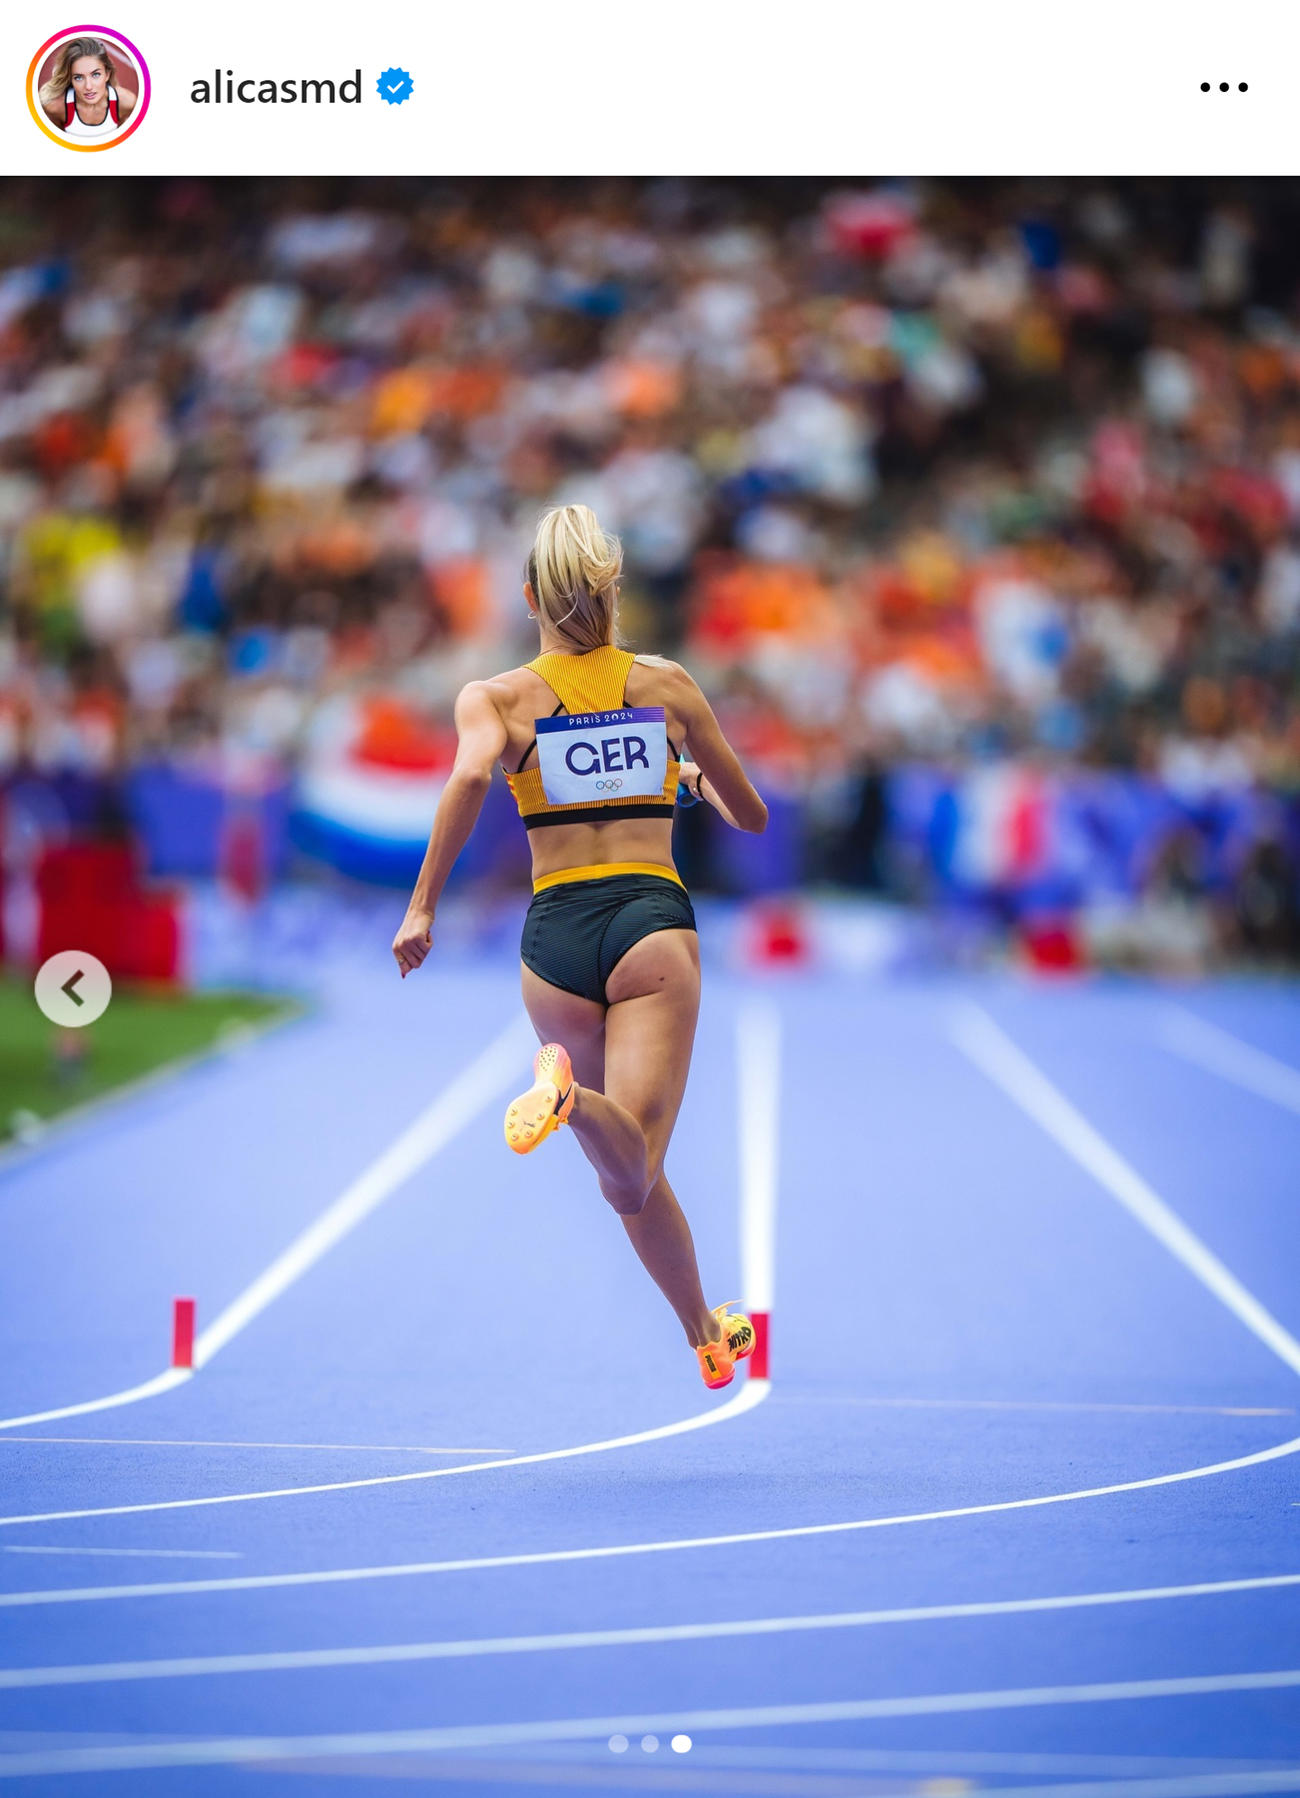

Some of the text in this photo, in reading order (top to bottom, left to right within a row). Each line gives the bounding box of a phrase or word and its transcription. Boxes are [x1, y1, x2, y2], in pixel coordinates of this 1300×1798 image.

[568, 712, 634, 726] PARIS 2024
[565, 736, 650, 776] GER
